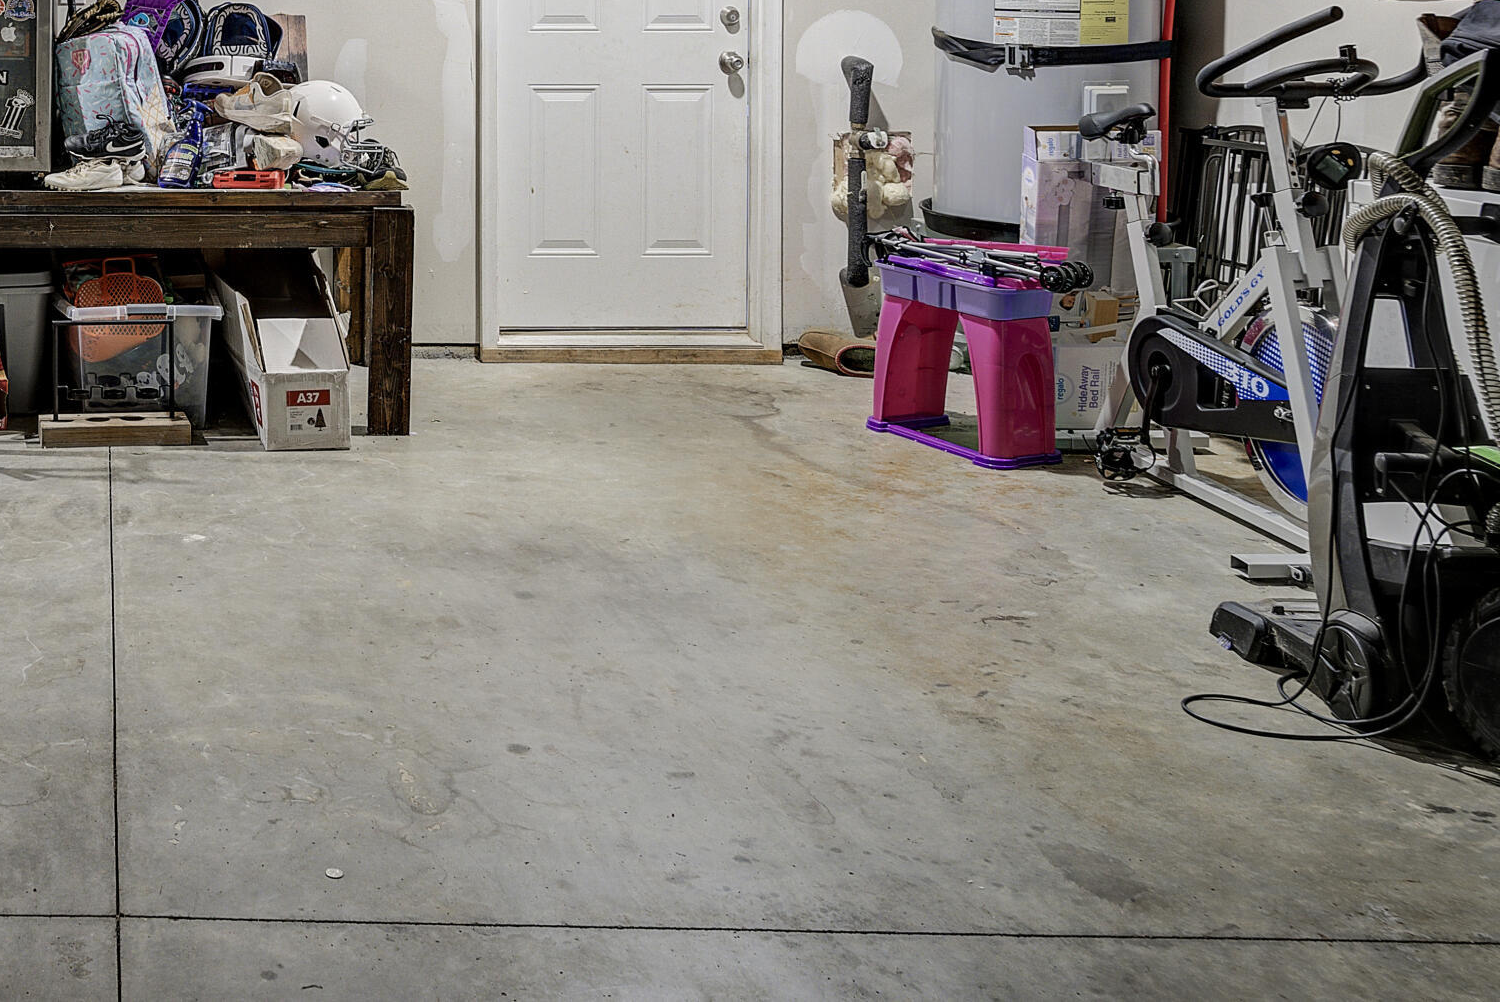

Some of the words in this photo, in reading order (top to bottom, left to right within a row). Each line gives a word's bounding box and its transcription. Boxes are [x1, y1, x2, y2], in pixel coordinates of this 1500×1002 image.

[1217, 287, 1250, 327] GOLD'S
[1250, 269, 1266, 289] GY
[1056, 377, 1066, 400] regalo
[1077, 365, 1091, 412] HideAway
[1090, 368, 1100, 388] Rail
[296, 392, 320, 403] A37
[1089, 389, 1099, 409] Bed
